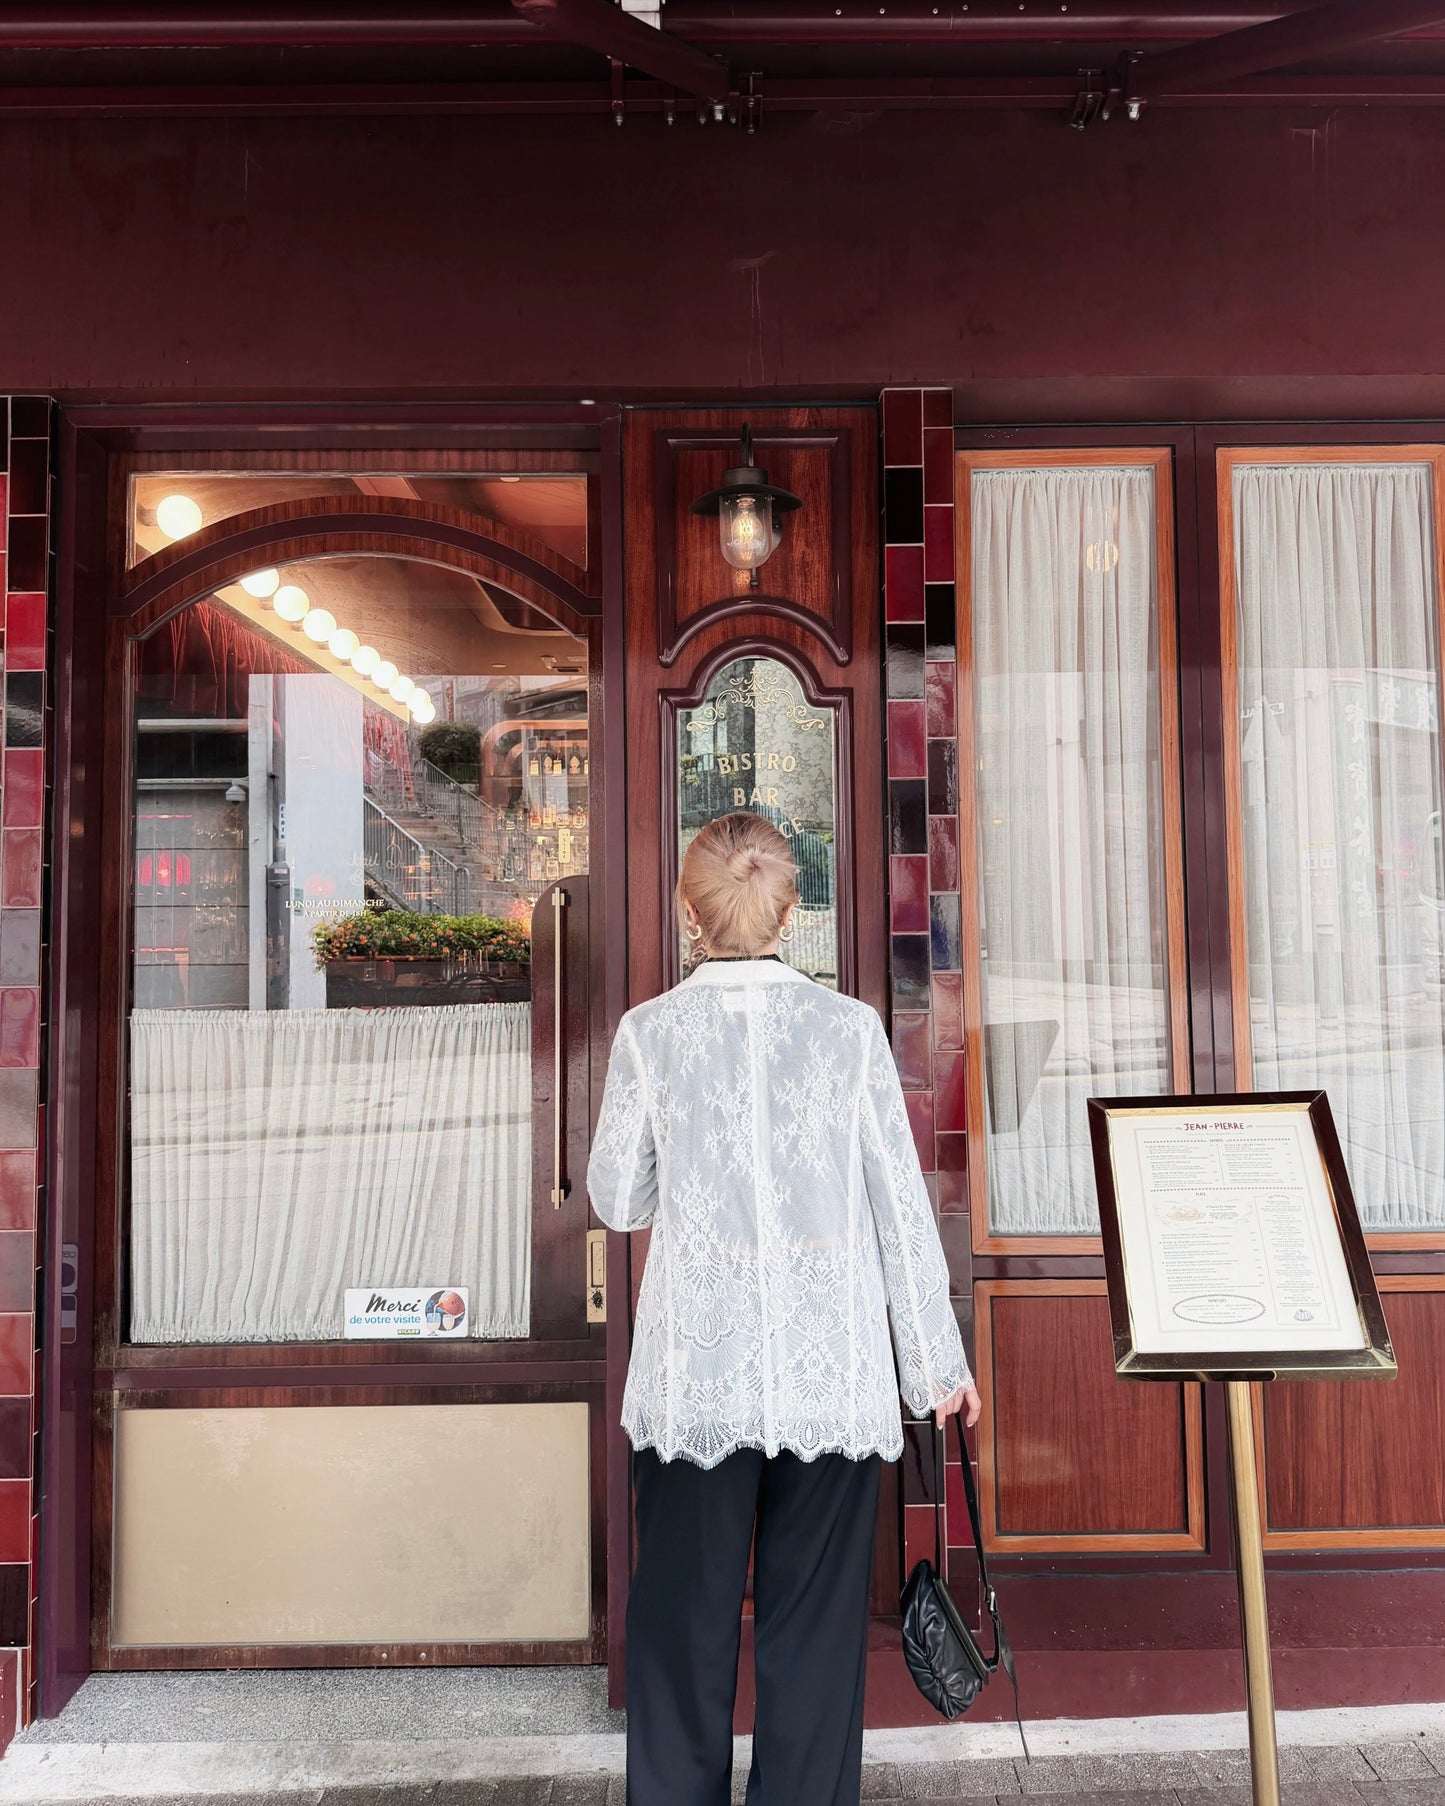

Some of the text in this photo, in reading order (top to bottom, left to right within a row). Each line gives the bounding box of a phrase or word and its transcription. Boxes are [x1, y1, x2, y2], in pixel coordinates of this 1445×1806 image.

[717, 752, 796, 776] BISTRO
[733, 786, 779, 807] BAR
[285, 898, 385, 908] LUNDI AU DIMANCHE
[365, 1293, 422, 1314] Merci
[349, 1314, 421, 1324] de votre visite
